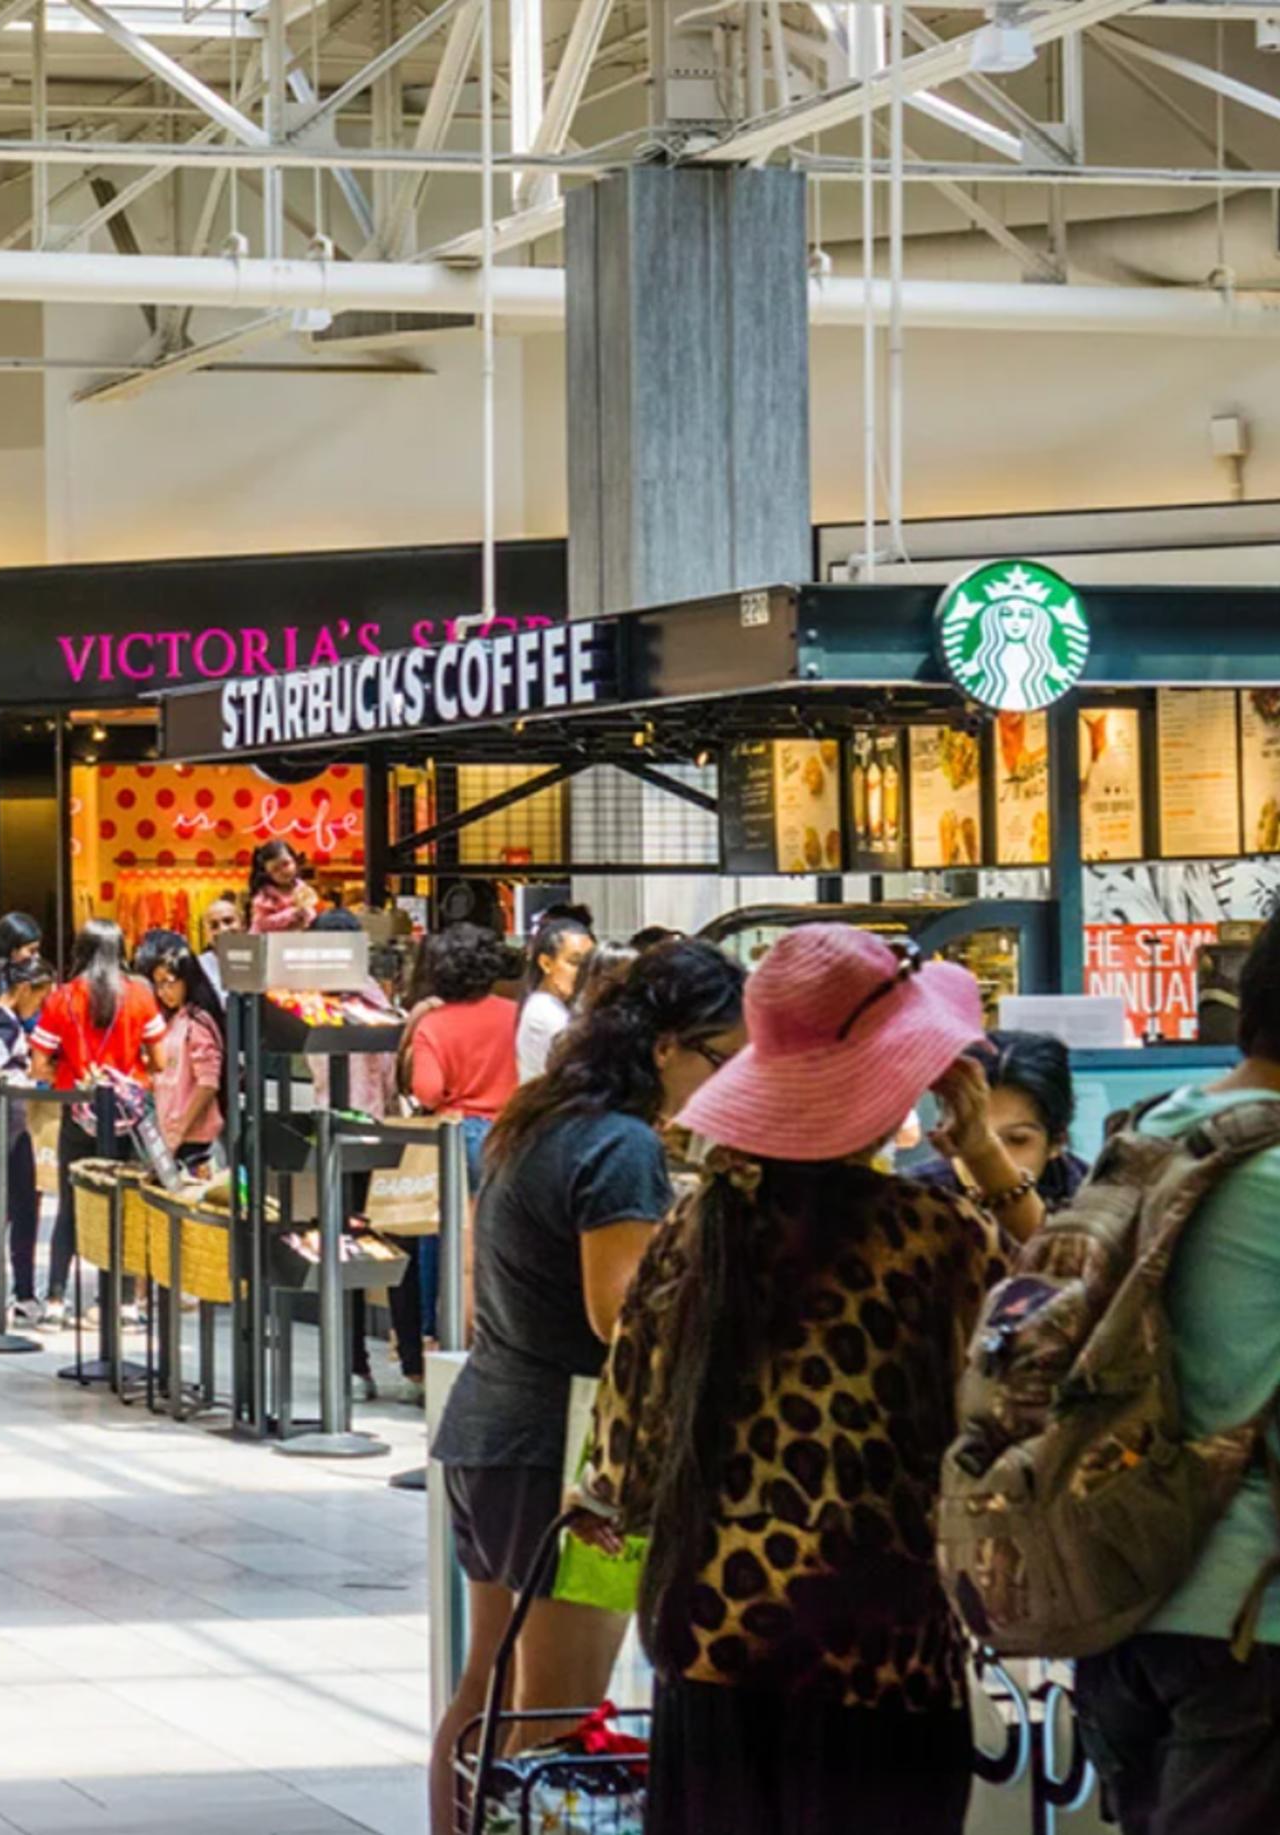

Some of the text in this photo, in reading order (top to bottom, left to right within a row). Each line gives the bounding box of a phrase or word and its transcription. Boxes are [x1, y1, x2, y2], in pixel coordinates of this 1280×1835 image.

[222, 621, 595, 750] STARBUCKS COFFEE
[241, 793, 365, 853] life
